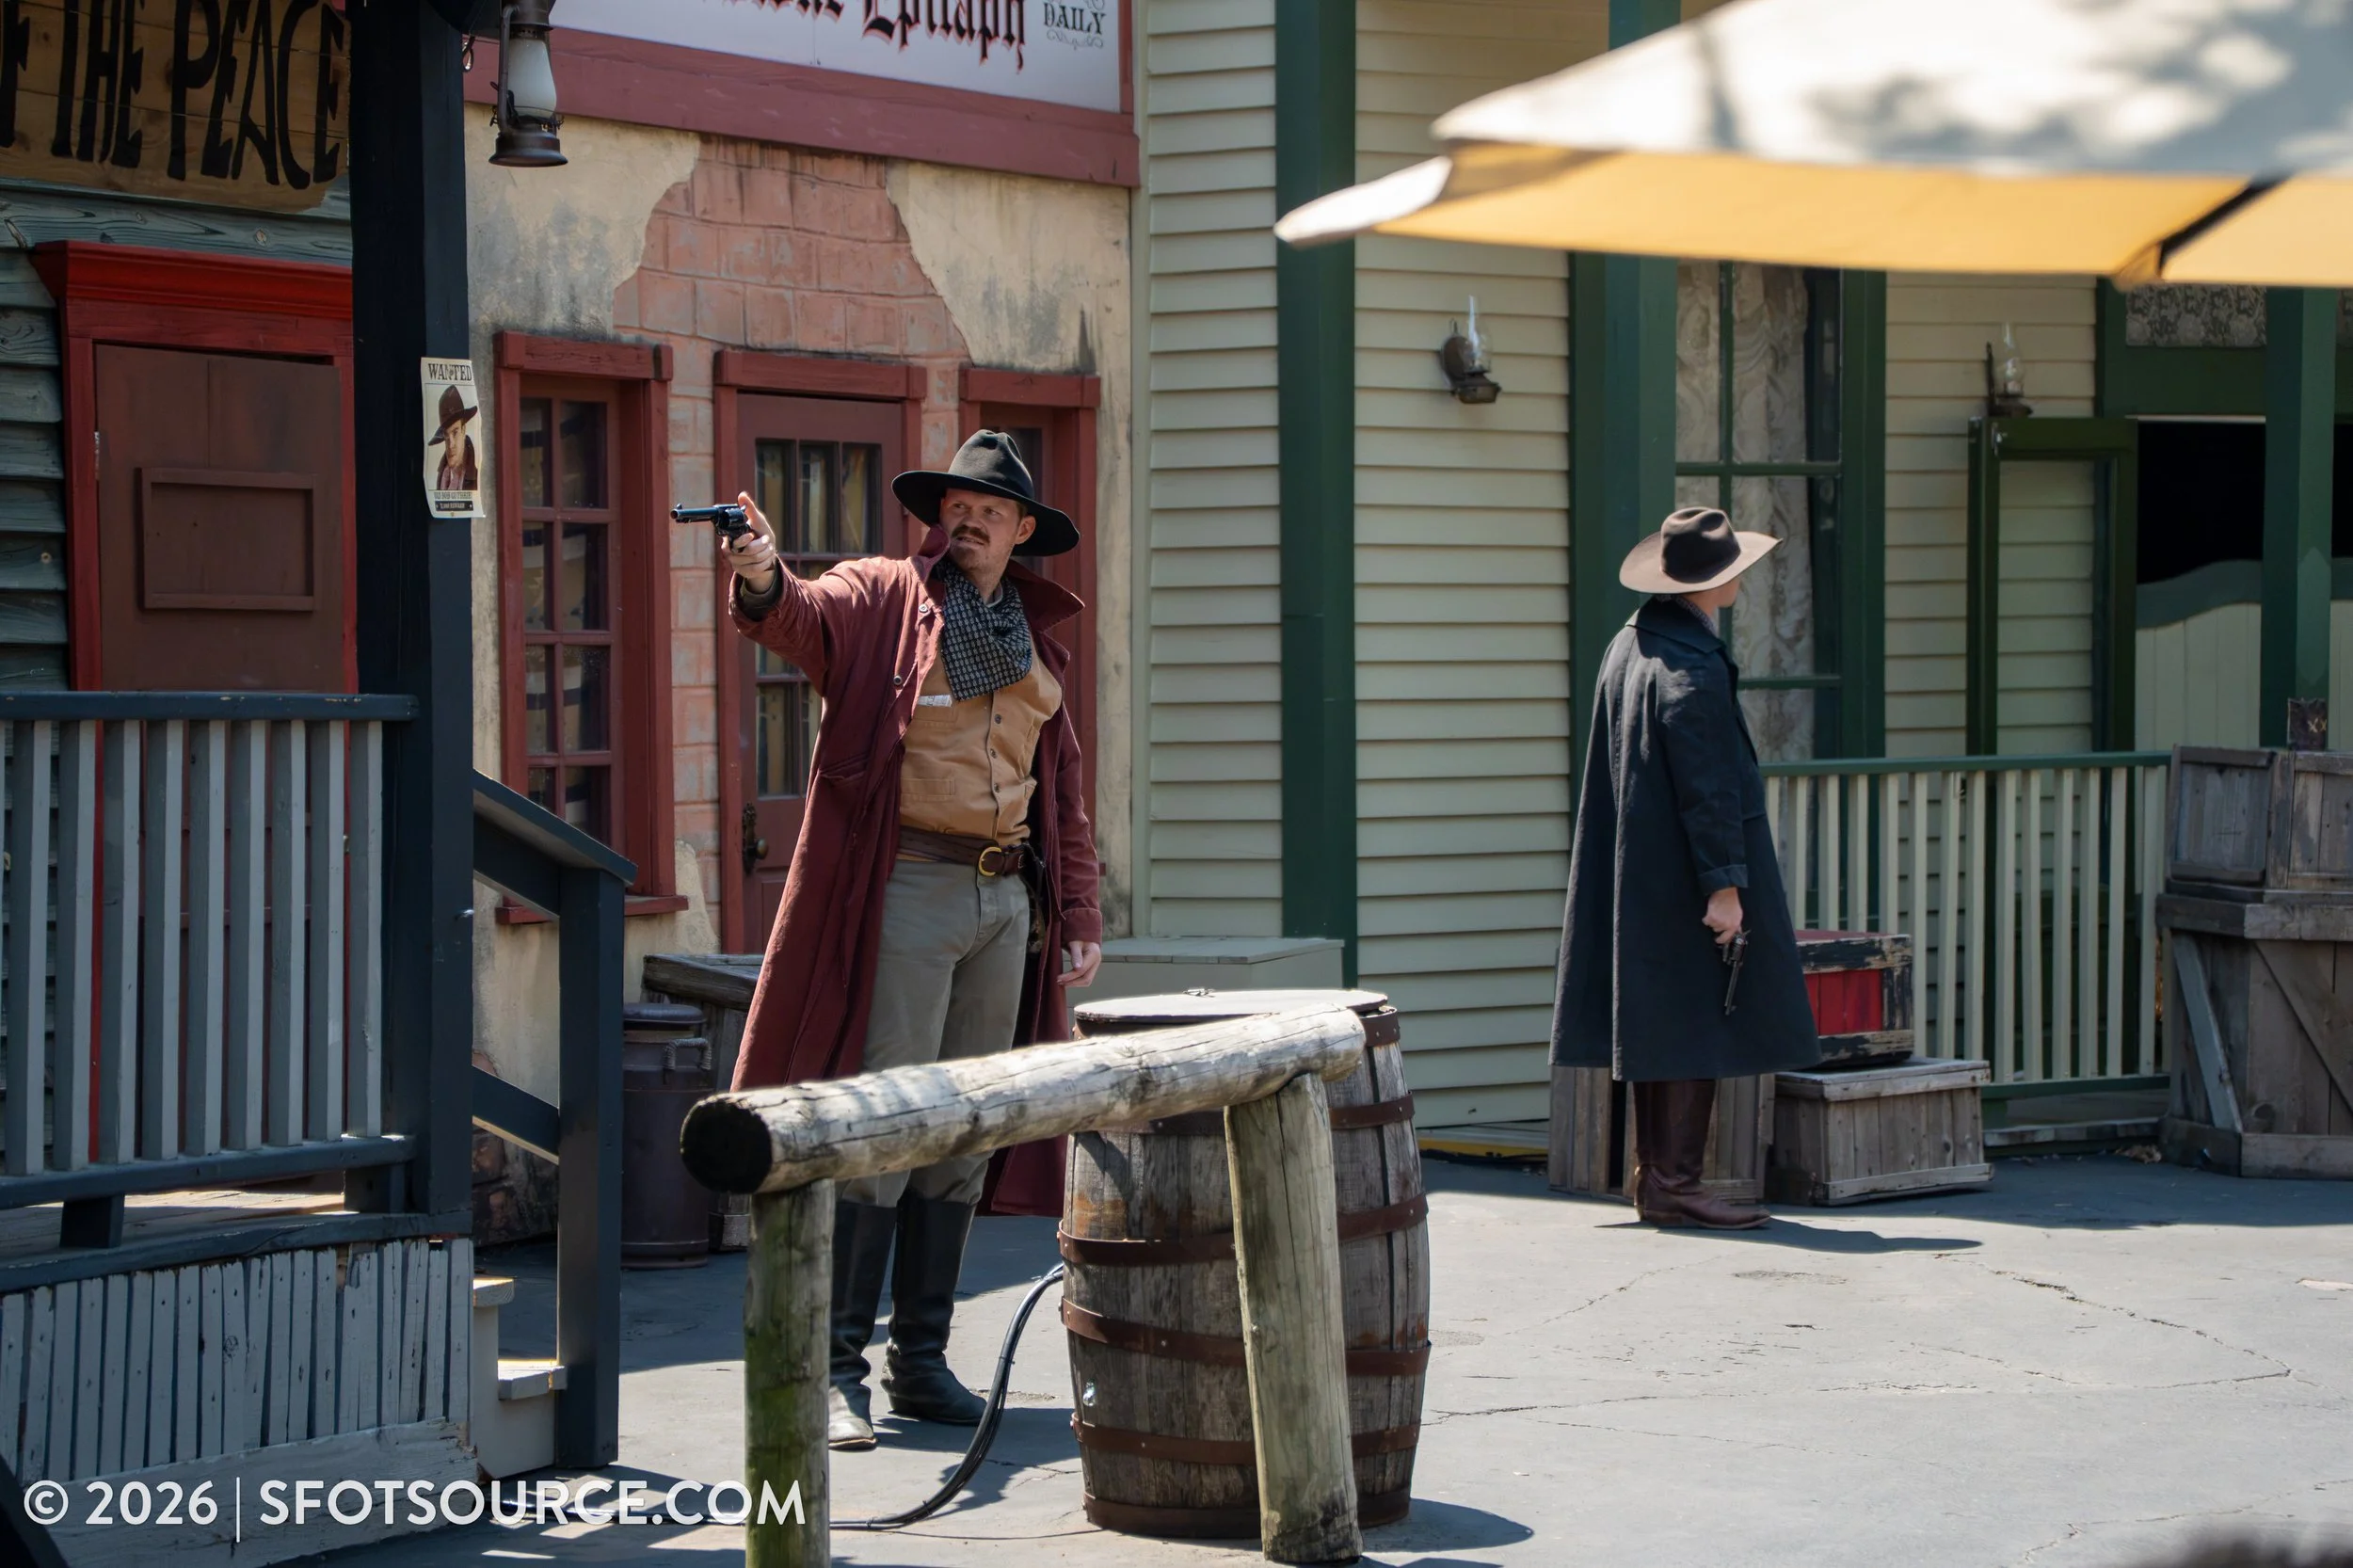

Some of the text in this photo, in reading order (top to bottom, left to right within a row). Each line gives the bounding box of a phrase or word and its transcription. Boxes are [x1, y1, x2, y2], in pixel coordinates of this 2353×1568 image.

[1043, 2, 1106, 35] DAILY
[51, 0, 144, 168] THE
[167, 0, 344, 189] PEACE
[427, 362, 472, 381] WANTED
